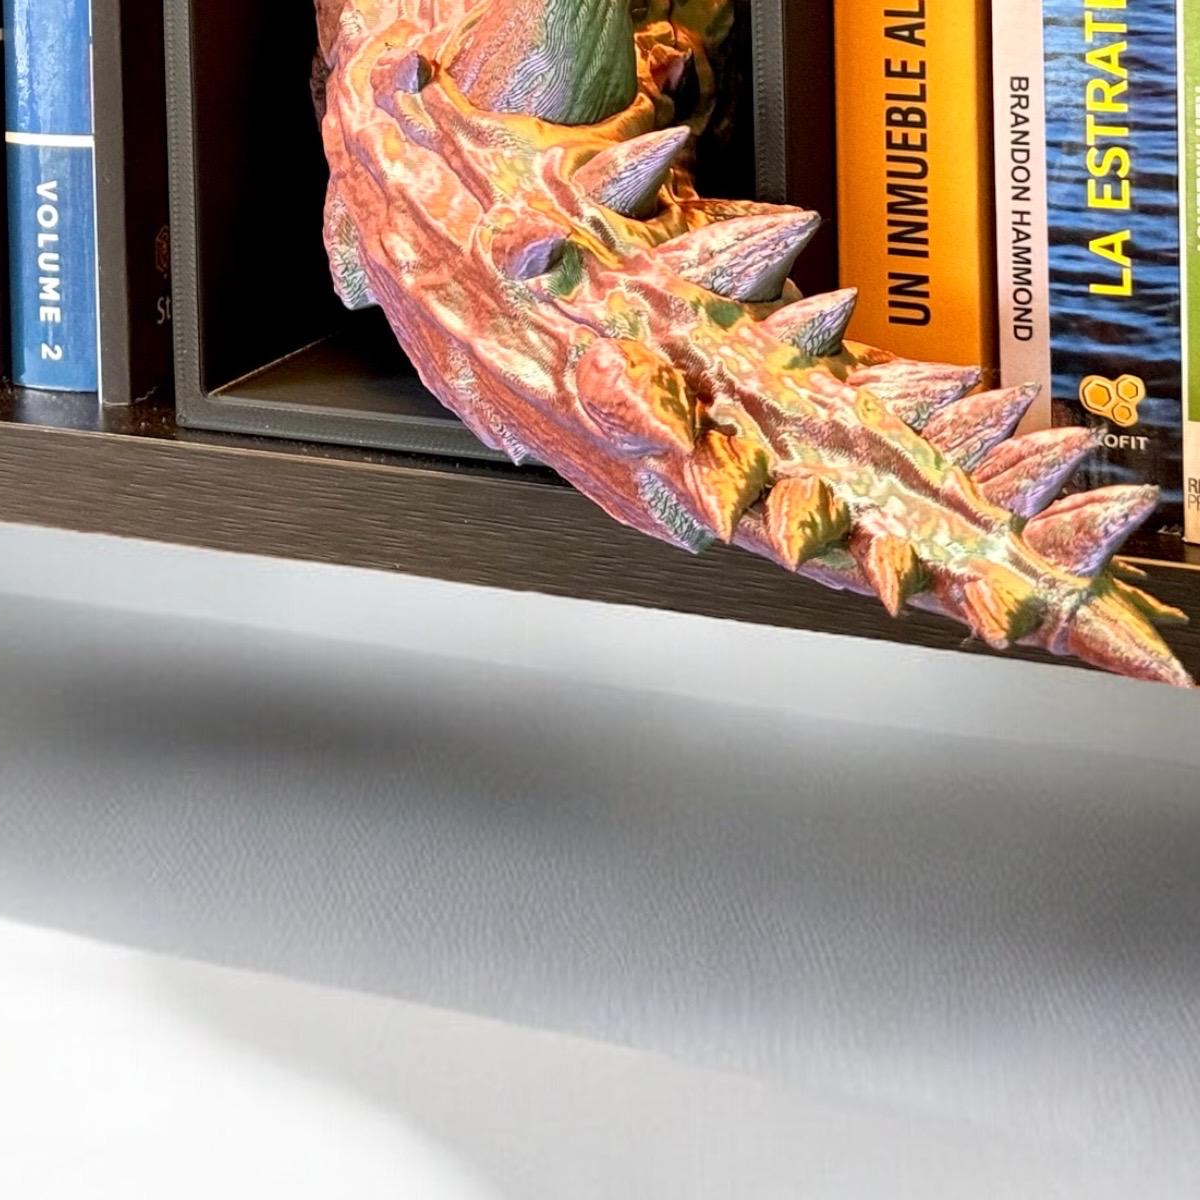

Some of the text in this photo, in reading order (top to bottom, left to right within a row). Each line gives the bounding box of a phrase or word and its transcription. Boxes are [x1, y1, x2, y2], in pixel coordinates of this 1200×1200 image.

[883, 0, 926, 48] AL
[885, 58, 930, 259] INMUEBLE
[1010, 76, 1033, 342] BRANDON HAMMOND
[36, 180, 63, 362] VOLUME 2
[1089, 229, 1134, 297] LA
[887, 272, 931, 327] UN
[1097, 436, 1148, 450] OFIT
